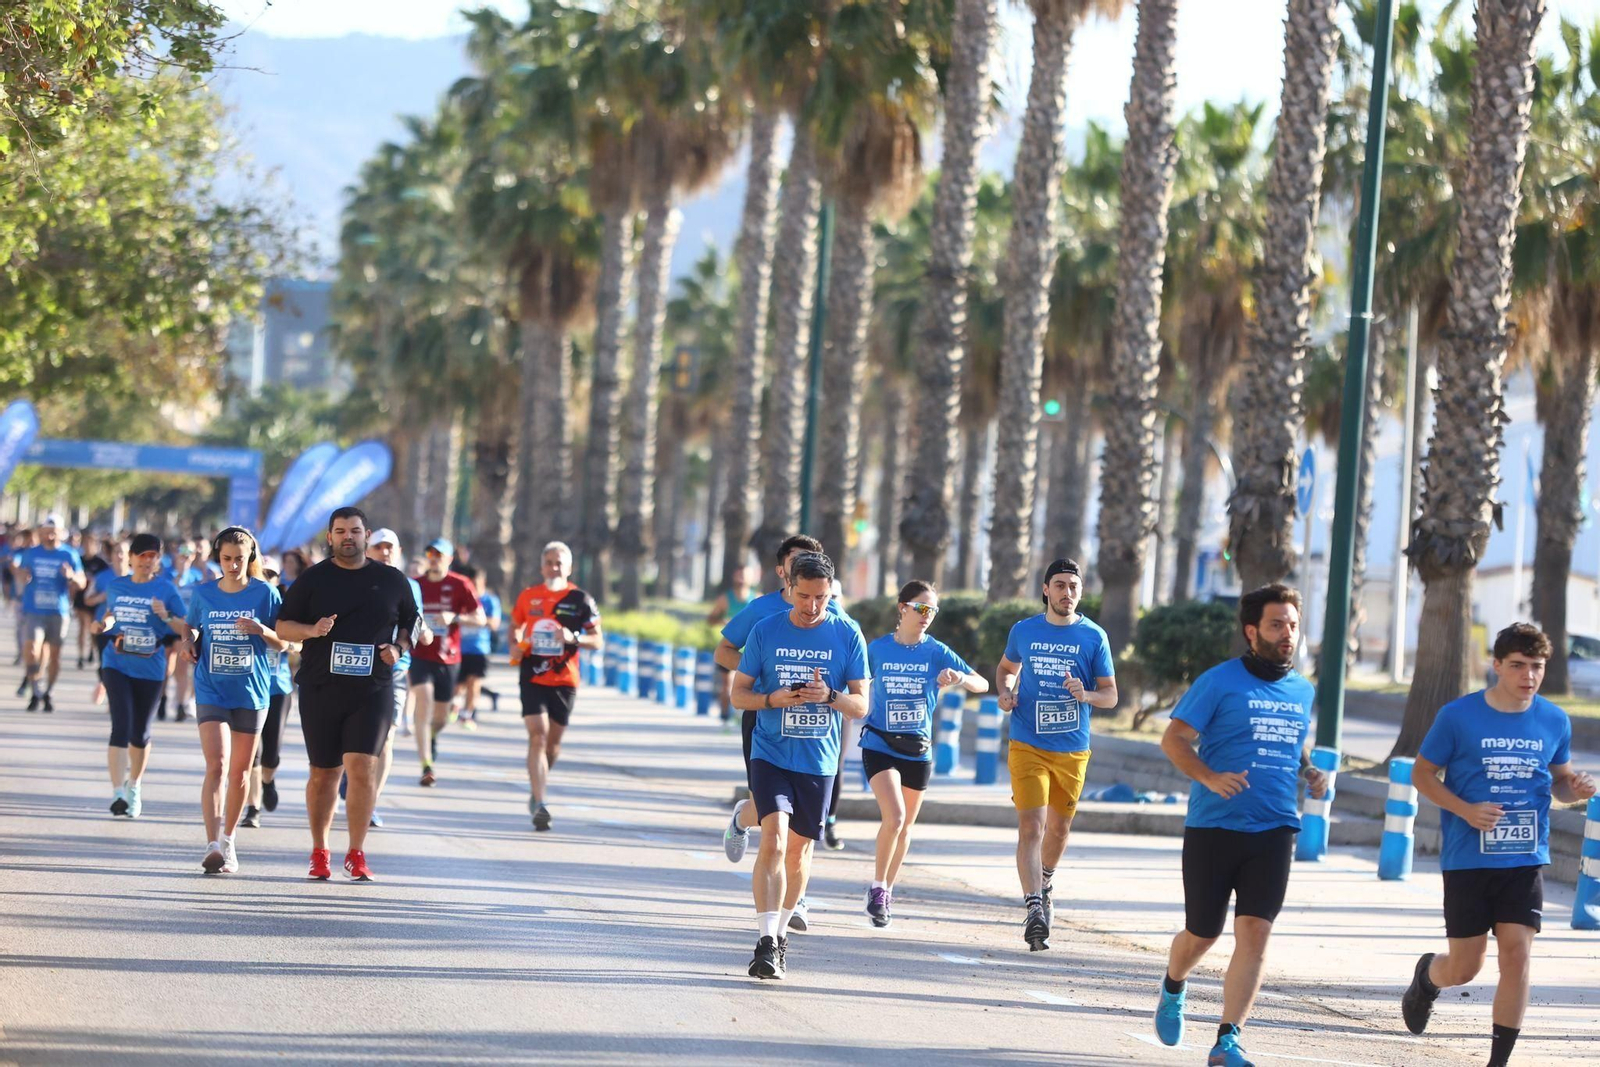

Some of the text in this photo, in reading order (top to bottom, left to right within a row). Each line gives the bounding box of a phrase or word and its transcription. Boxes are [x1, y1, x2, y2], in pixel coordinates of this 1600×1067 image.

[115, 596, 153, 605] mayora
[208, 608, 255, 619] mayoral
[1030, 642, 1080, 654] mayoral
[775, 648, 832, 660] mayoral
[216, 655, 247, 665] 1821
[337, 655, 368, 665] 1879
[1029, 656, 1076, 666] RUNNING
[882, 662, 929, 672] mayoral
[1033, 663, 1071, 671] MAKES
[1248, 700, 1304, 714] mayoral
[789, 714, 827, 725] 1893
[892, 711, 923, 720] 1616
[1042, 712, 1075, 723] 2158
[1249, 717, 1305, 730] RUNNING
[1255, 725, 1299, 736] MAKES
[1253, 732, 1298, 744] FRIENDS
[1481, 738, 1543, 751] mayoral
[1482, 757, 1539, 767] RUNNING
[1487, 765, 1534, 773] MAKES
[1487, 771, 1533, 780] FRIENDS
[1493, 827, 1531, 839] 1748
